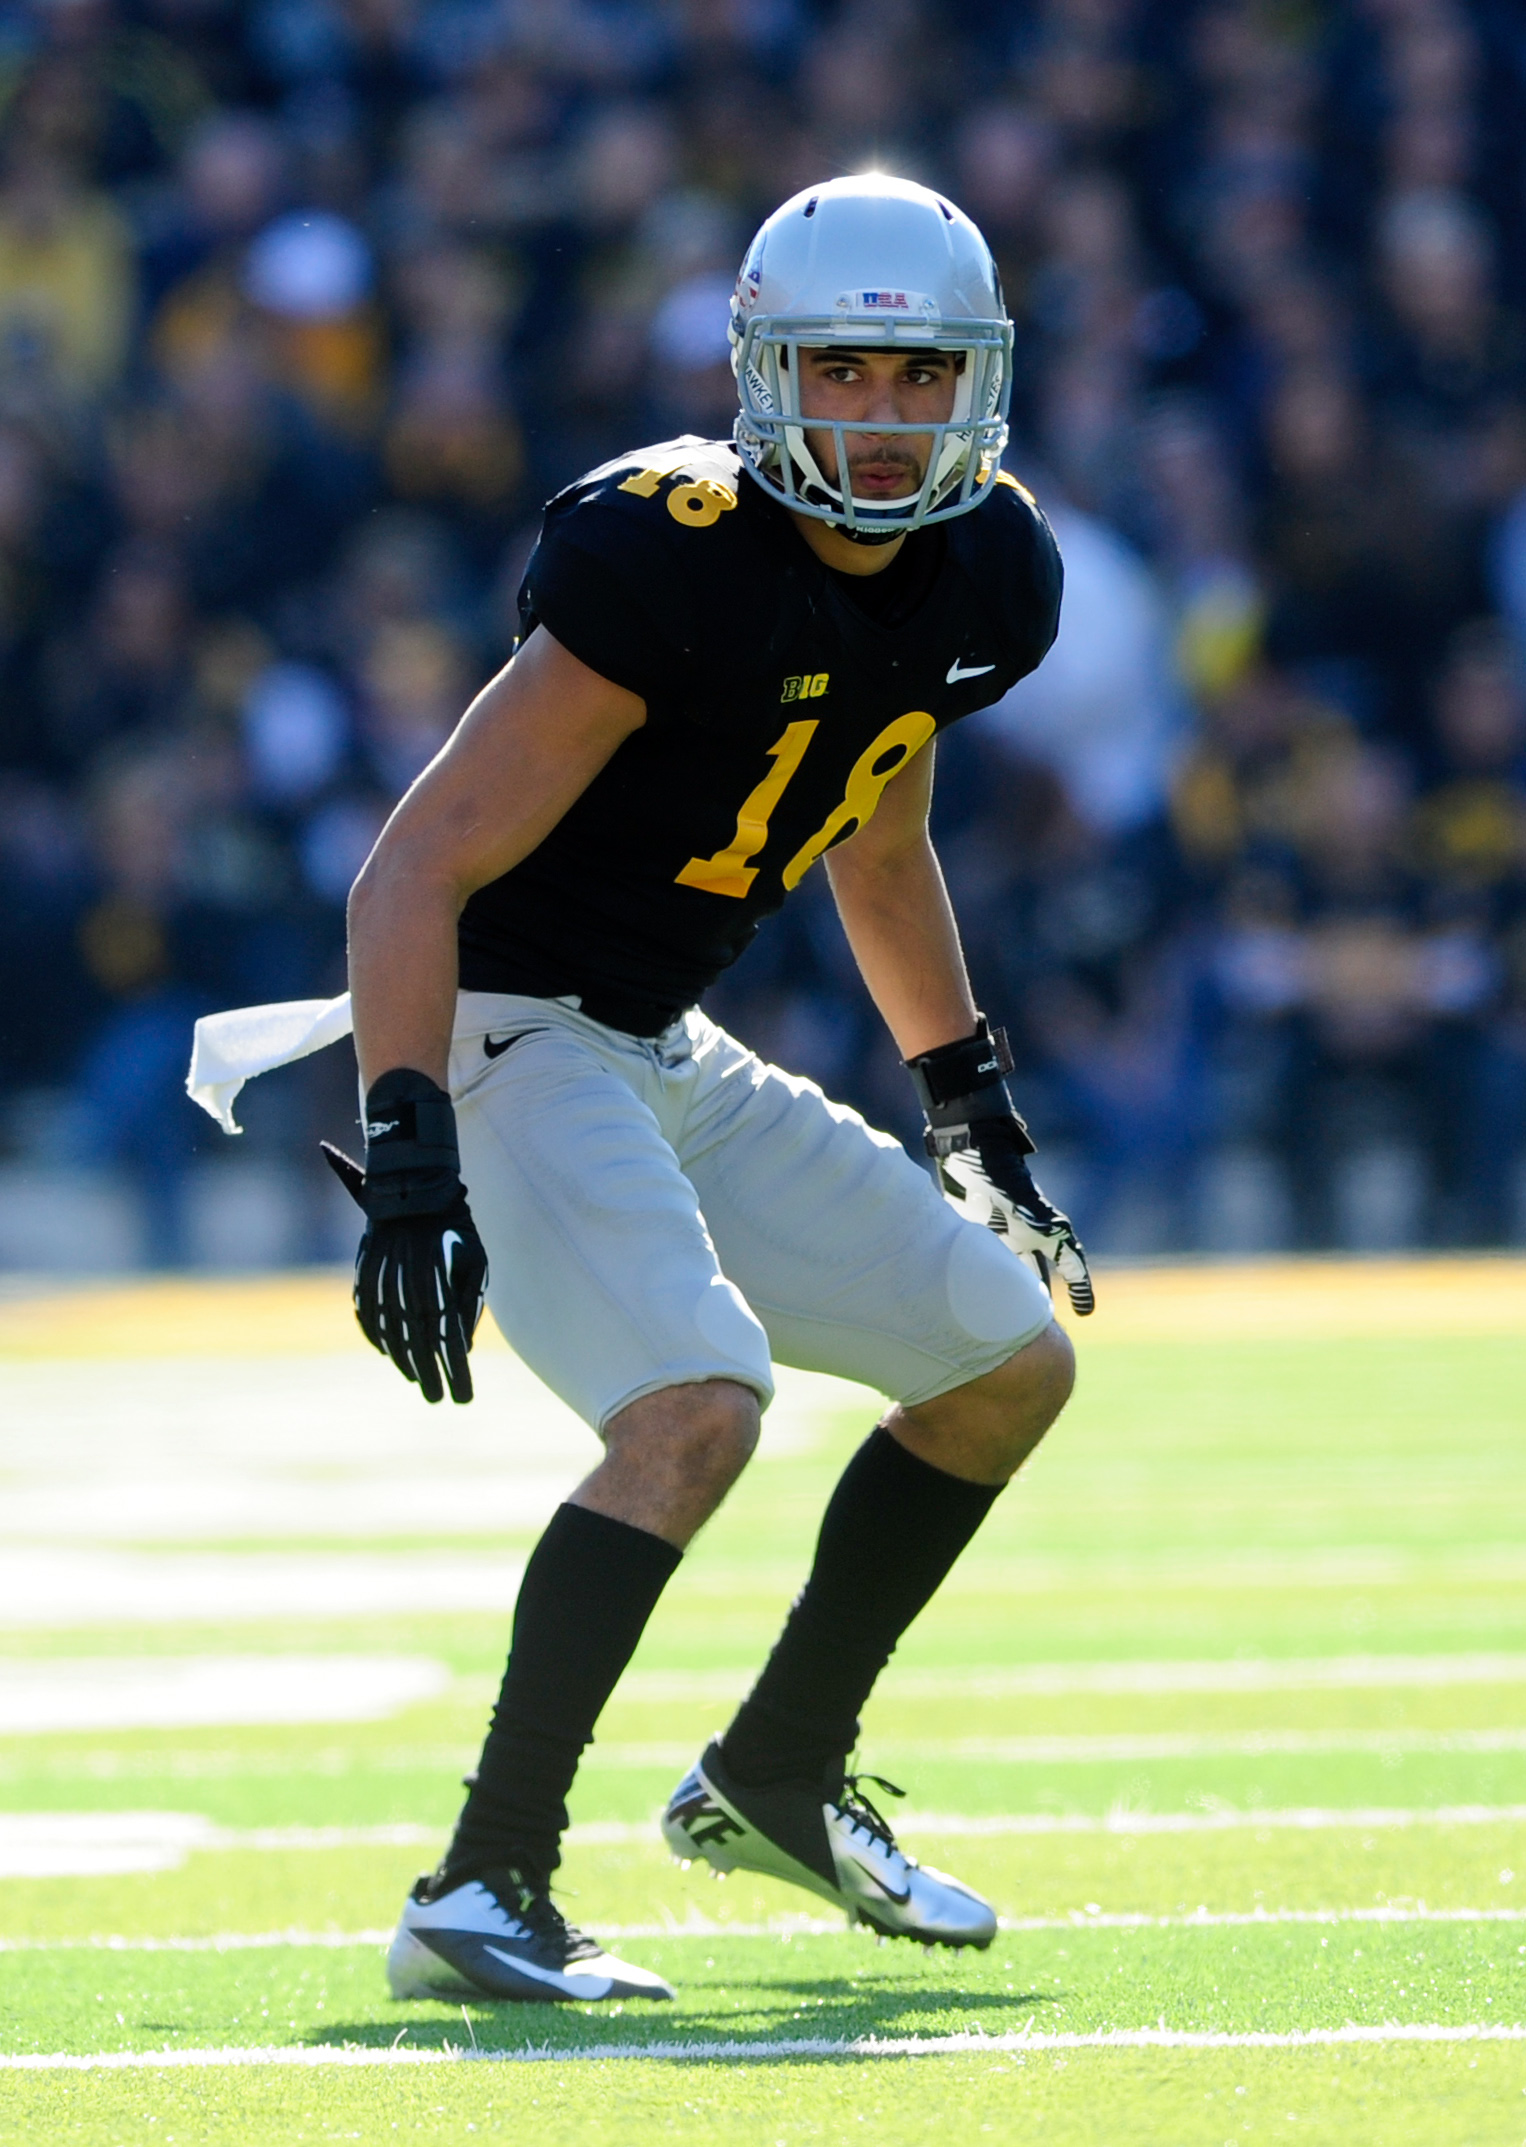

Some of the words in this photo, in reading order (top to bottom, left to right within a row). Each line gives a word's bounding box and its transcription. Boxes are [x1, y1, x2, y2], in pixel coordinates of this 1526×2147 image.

[862, 291, 909, 309] USA
[616, 464, 738, 528] 18
[673, 710, 937, 899] 18
